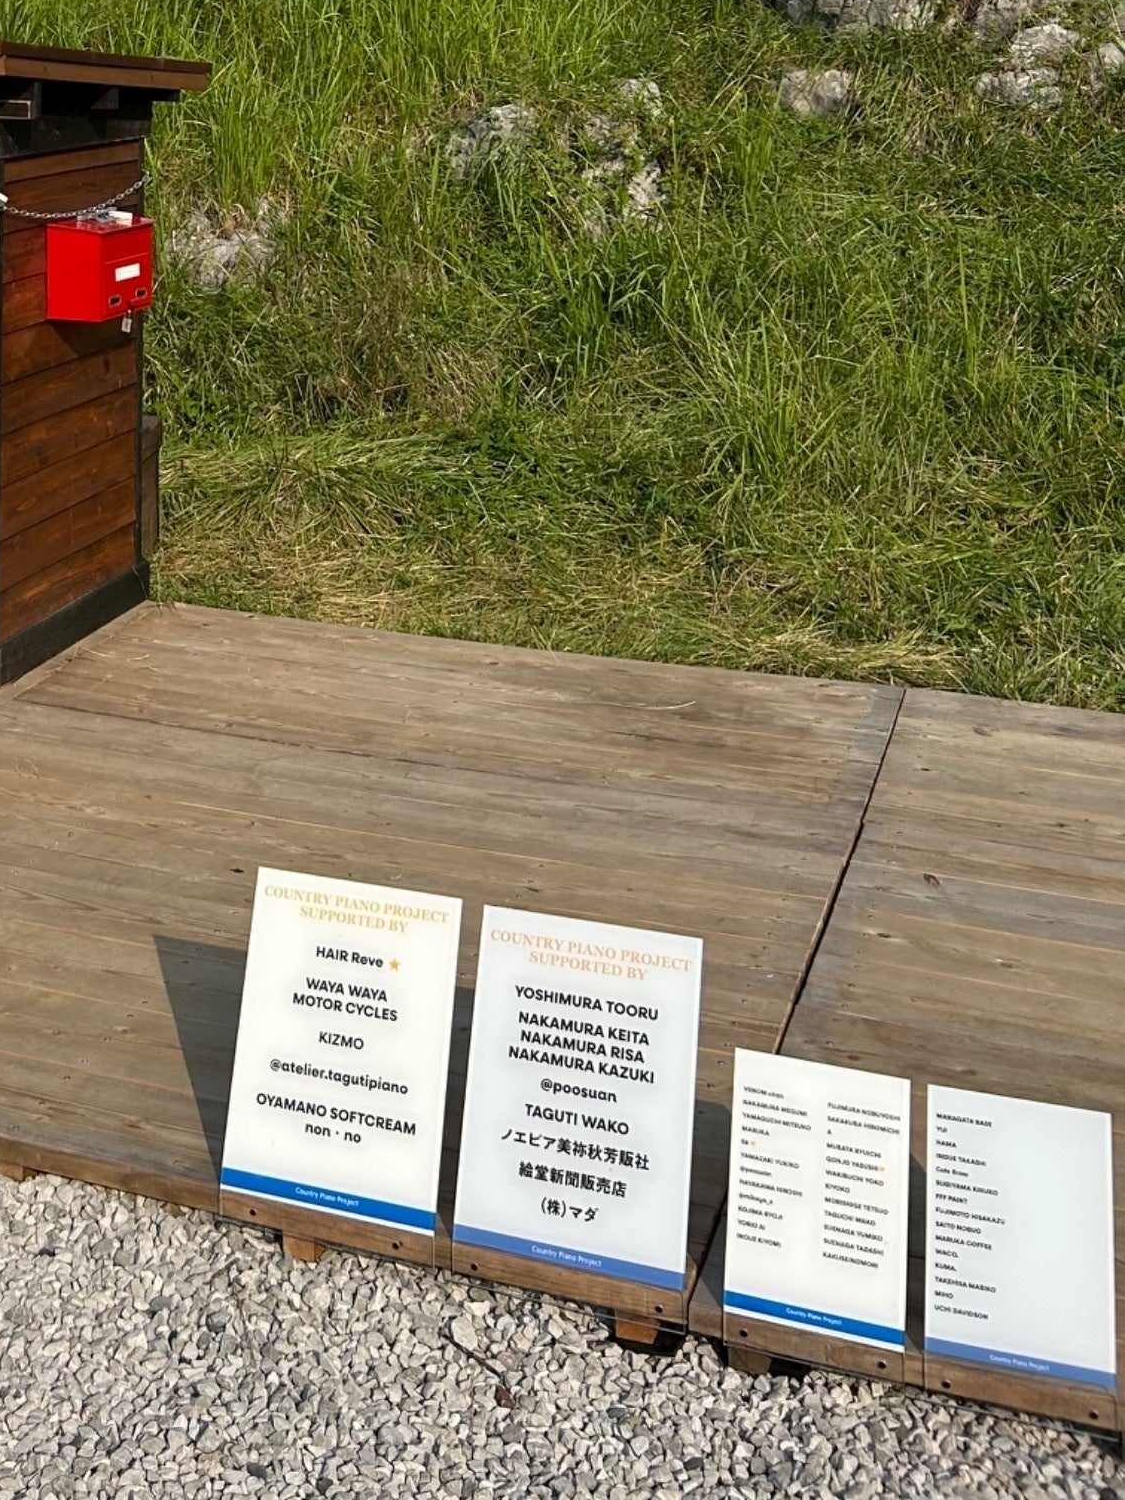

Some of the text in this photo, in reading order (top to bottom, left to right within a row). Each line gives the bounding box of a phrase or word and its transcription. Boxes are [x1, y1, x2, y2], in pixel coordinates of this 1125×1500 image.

[264, 885, 449, 923] COUNTRY PIANO PROJECT
[300, 906, 408, 932] SUPPORTED BY
[315, 945, 383, 967] HAIR Reve
[490, 929, 692, 971] COUNTRY PIANO PROJECT
[529, 950, 647, 980] SUPPORTED BY
[305, 977, 387, 1002] WAYA WAYA
[514, 984, 658, 1021] YOSHIMURA TOORU
[292, 992, 397, 1021] MOTOR CYCLES
[318, 1031, 364, 1050] KIZMO
[518, 1011, 649, 1045] NAKAMURA KEITA
[520, 1029, 644, 1063] NAKAMURA RISA
[269, 1058, 408, 1094] @atelier.tagutipiano
[508, 1045, 654, 1084] NAKAMURA KAZUKI
[539, 1078, 616, 1103] @poosuan
[256, 1092, 415, 1135] OYAMANO SOFTCREAM
[524, 1103, 629, 1135] TAGUTI WAKO
[304, 1123, 361, 1143] non no
[518, 1160, 626, 1198] 絵堂新聞販売店
[294, 1186, 359, 1206] Country Piano Project
[531, 1244, 601, 1266] Country Piano Project
